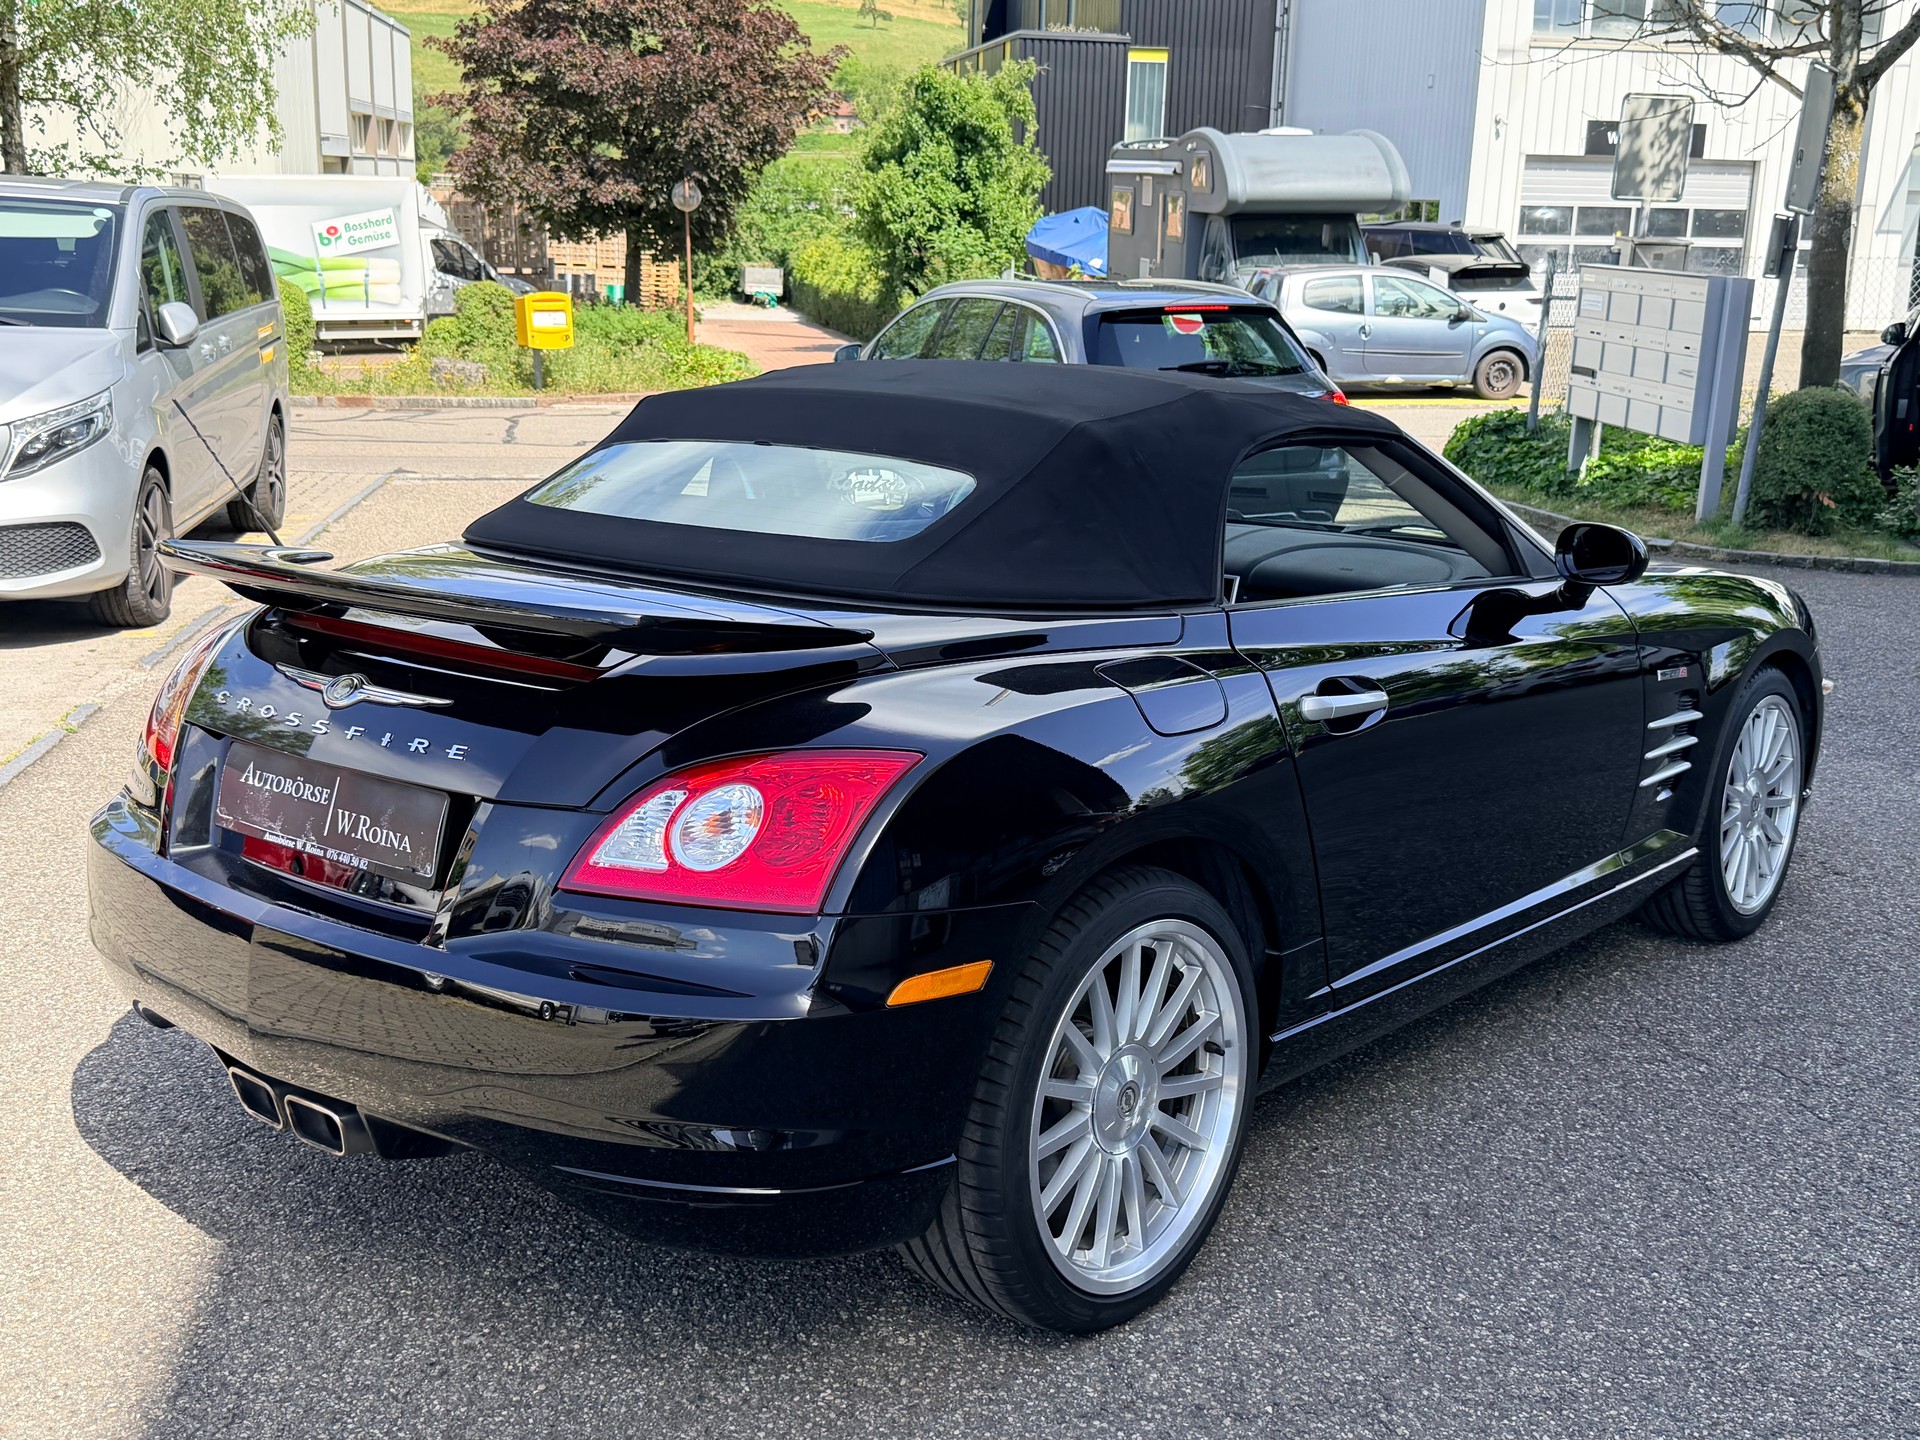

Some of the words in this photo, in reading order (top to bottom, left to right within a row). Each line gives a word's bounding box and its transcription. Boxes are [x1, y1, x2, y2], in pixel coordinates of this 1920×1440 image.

[344, 215, 392, 233] Bosshard
[348, 231, 391, 246] Gemüse
[215, 690, 470, 761] CROSSFIRE
[239, 761, 331, 805] AUTOBÖRSE
[305, 842, 324, 857] Roina
[326, 849, 338, 861] 076
[359, 859, 369, 870] 82
